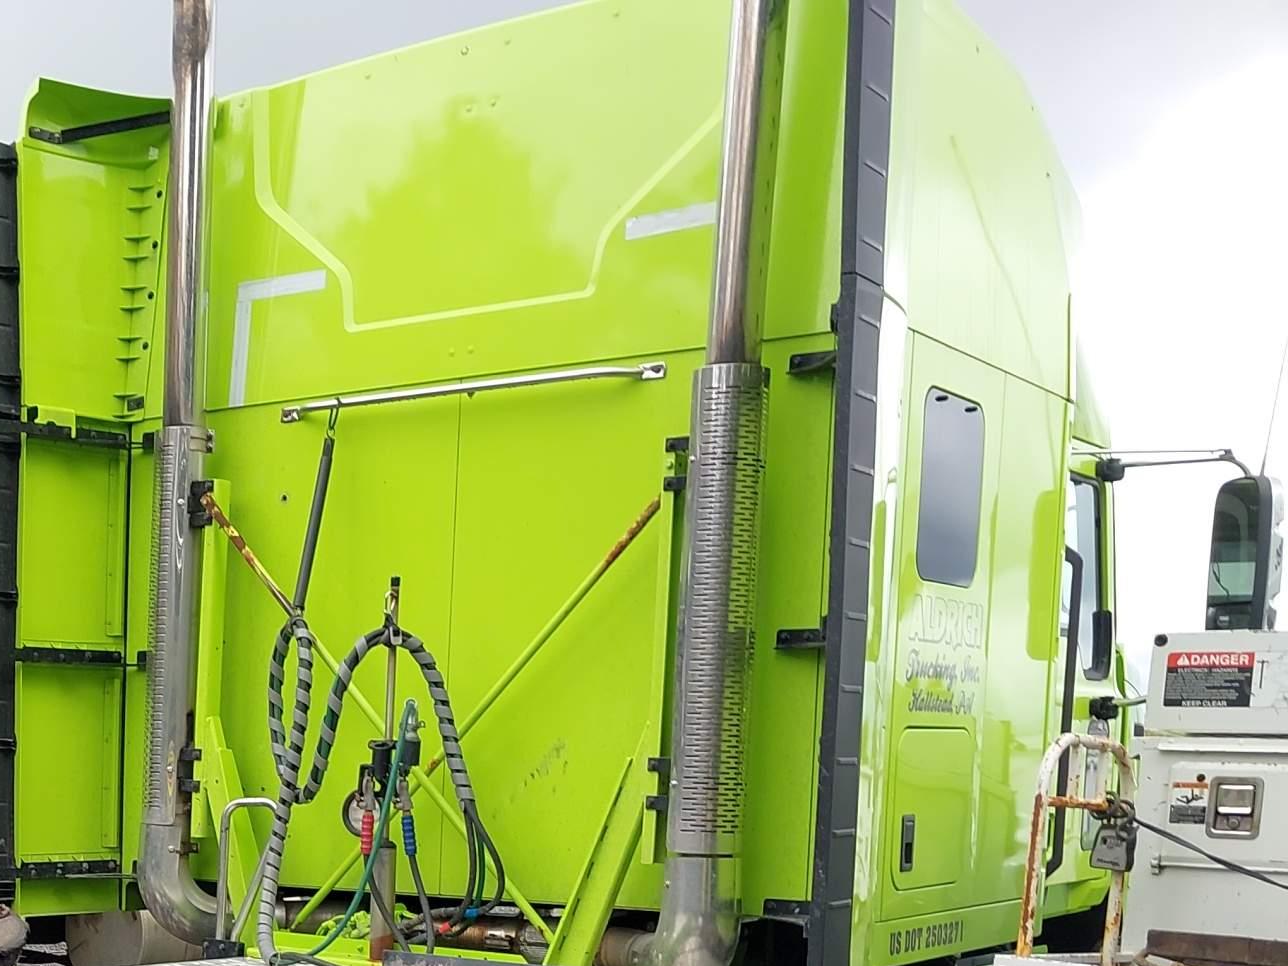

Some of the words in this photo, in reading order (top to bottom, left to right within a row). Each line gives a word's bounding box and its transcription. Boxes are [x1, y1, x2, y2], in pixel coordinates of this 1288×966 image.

[908, 593, 983, 651] ALDRICH
[960, 655, 980, 683] Inc.
[1191, 654, 1250, 666] DANGER
[889, 932, 902, 956] US
[904, 928, 923, 953] DOT
[925, 920, 964, 948] 2503271
